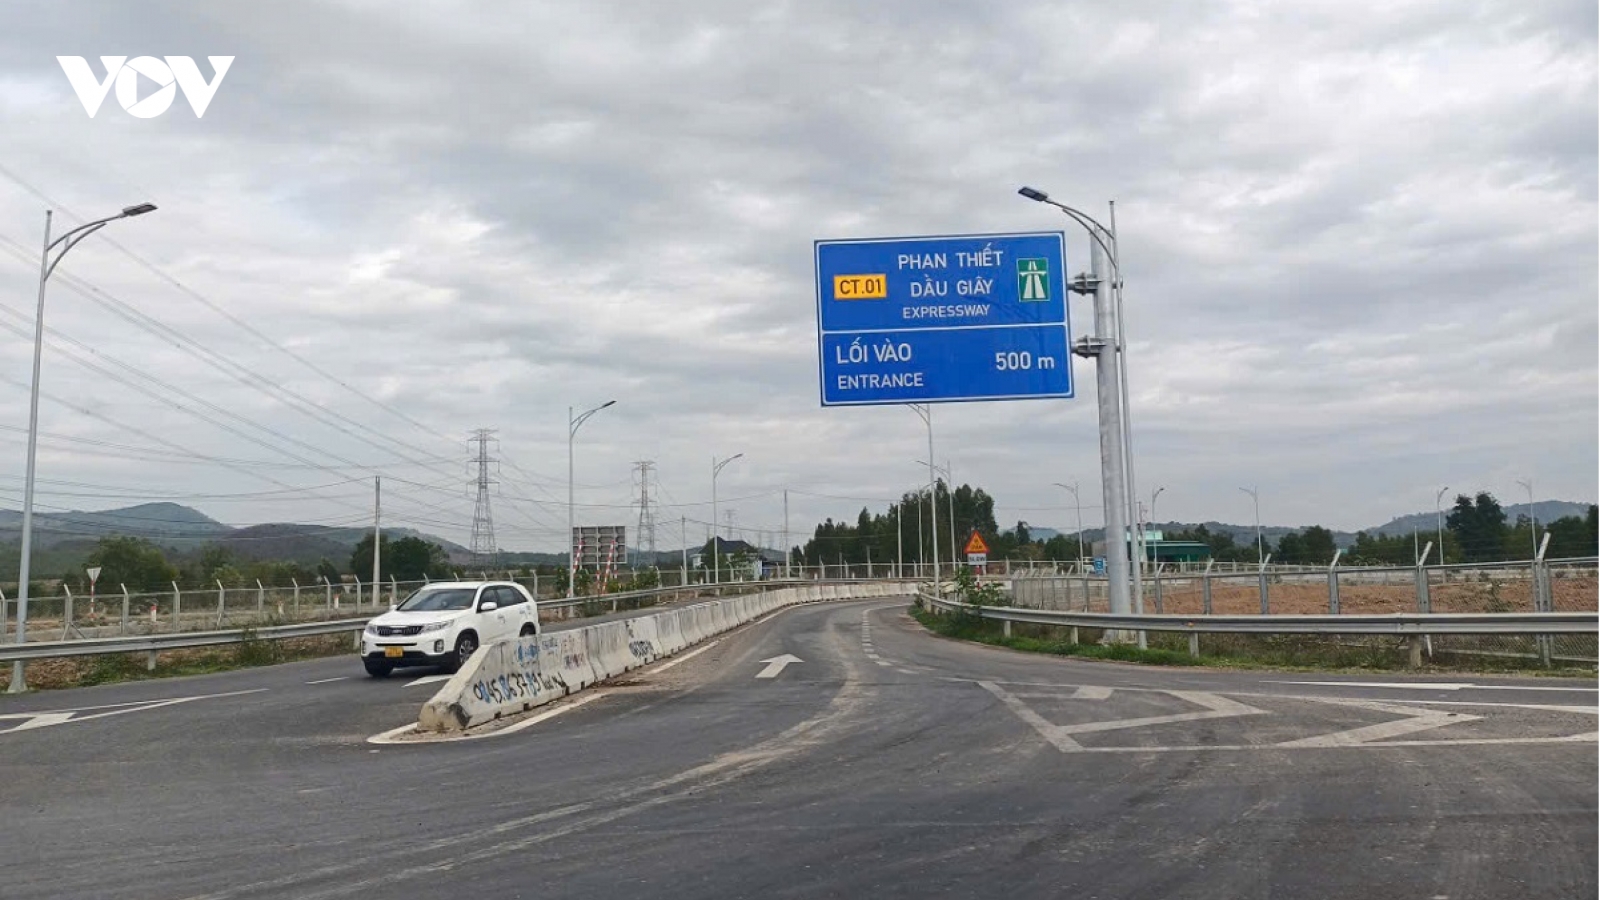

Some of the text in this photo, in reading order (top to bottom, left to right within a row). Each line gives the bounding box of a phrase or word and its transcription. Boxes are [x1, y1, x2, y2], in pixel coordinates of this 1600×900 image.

[898, 242, 1004, 270] PHAN THIẾT
[839, 279, 882, 295] CT.01
[910, 274, 994, 298] DẦU GIÂY
[902, 304, 991, 319] EXPRESSWAY
[836, 337, 912, 365] LỐI VÀO
[995, 352, 1055, 371] 500 m
[837, 373, 924, 390] ENTRANCE
